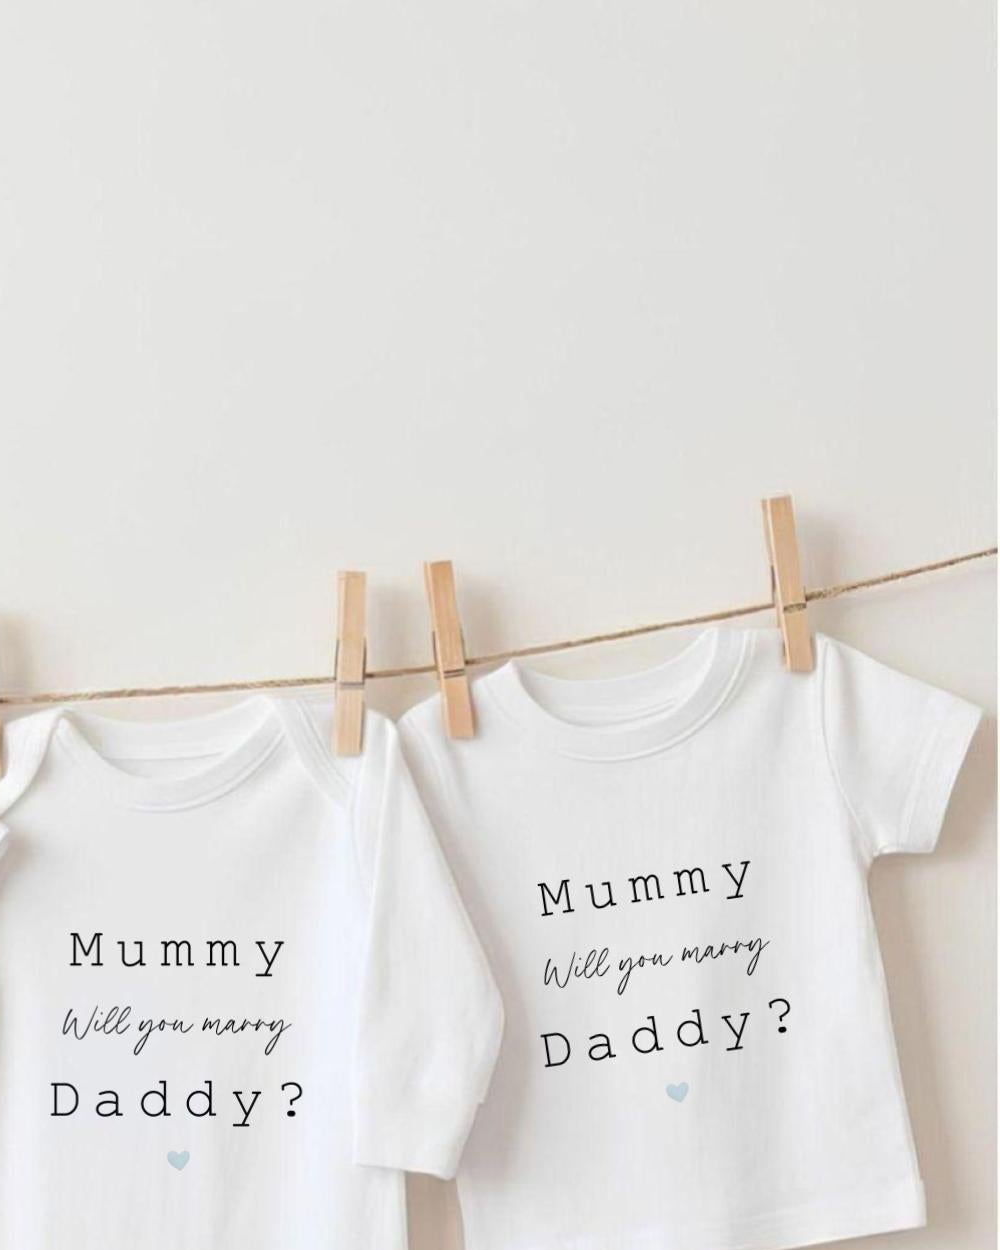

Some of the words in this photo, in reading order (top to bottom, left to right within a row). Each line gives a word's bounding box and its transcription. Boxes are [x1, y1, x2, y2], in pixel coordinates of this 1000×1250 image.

[538, 861, 752, 916] Mummy
[70, 933, 284, 977] Mummy
[543, 952, 611, 988] Will
[617, 948, 673, 995] you
[681, 935, 770, 976] marry
[62, 1006, 131, 1040] Will
[130, 1018, 193, 1055] you
[201, 1018, 292, 1055] marry
[540, 998, 791, 1067] Daddy?
[51, 1081, 303, 1127] Daddy?
